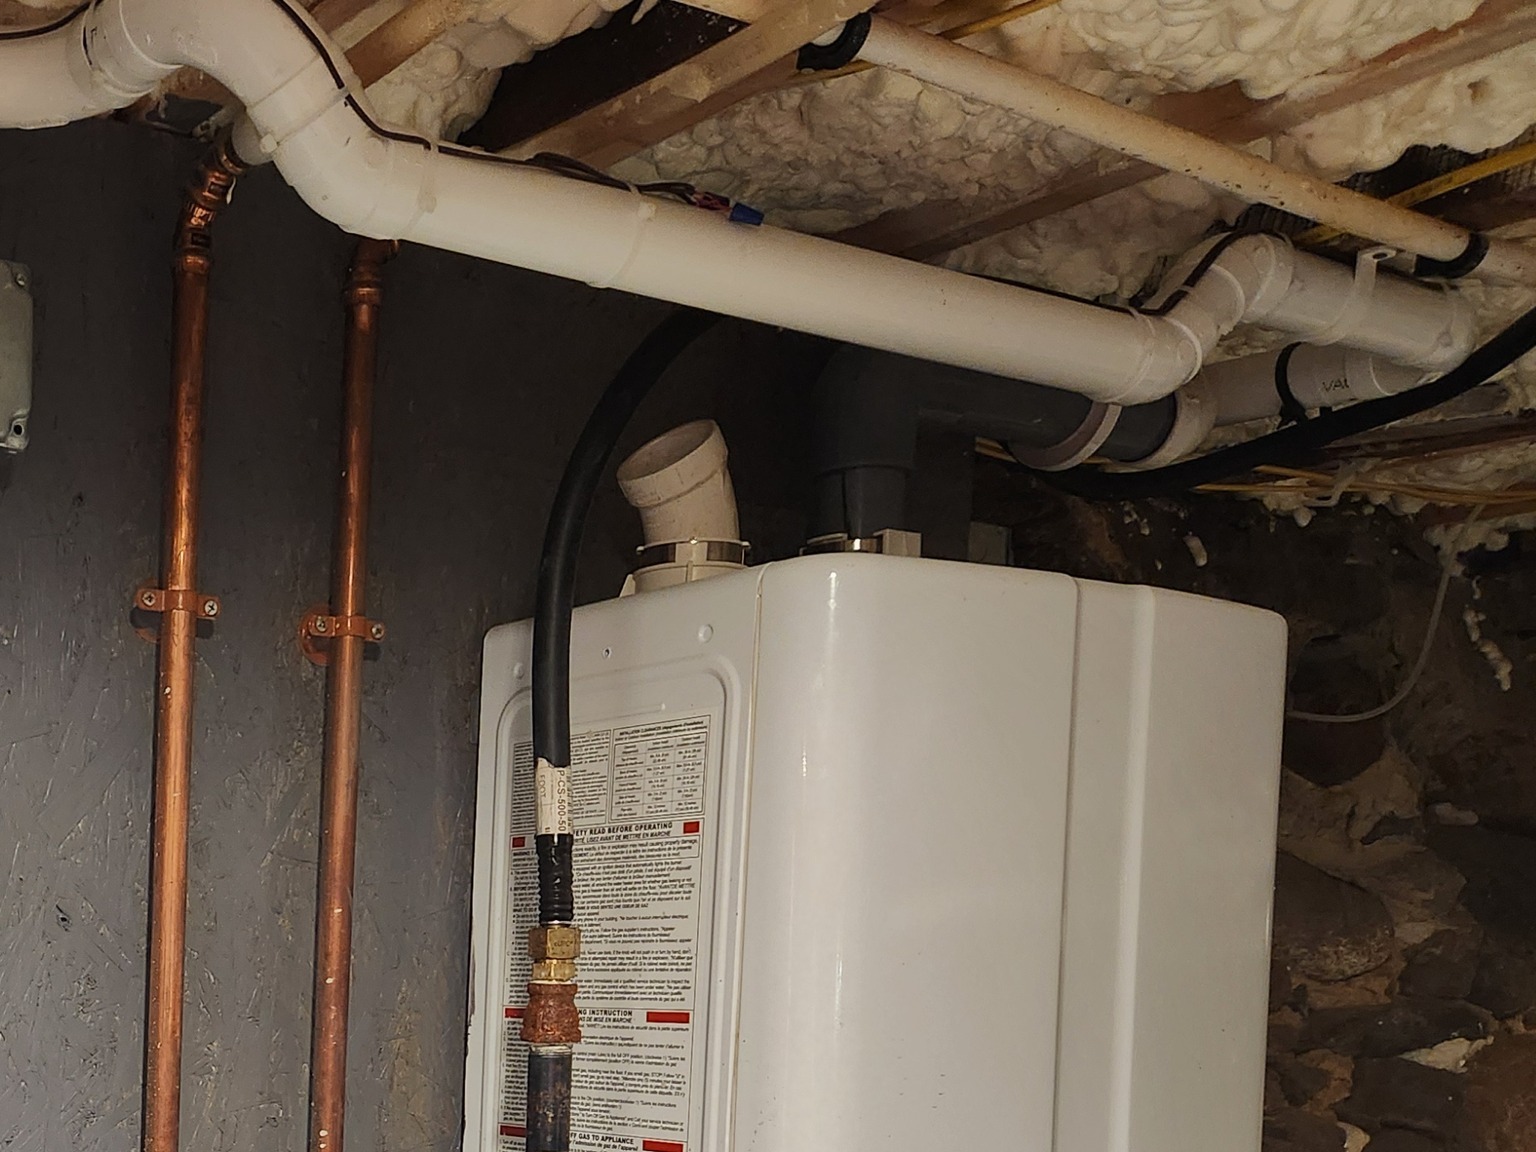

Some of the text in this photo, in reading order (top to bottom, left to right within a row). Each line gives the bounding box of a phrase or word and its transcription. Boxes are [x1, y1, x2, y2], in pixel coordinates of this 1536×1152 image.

[608, 826, 632, 834] BEFORE
[634, 822, 673, 831] OPERATING
[589, 1009, 633, 1017] INSTRUCTION
[600, 1135, 634, 1145] APPLIANCE
